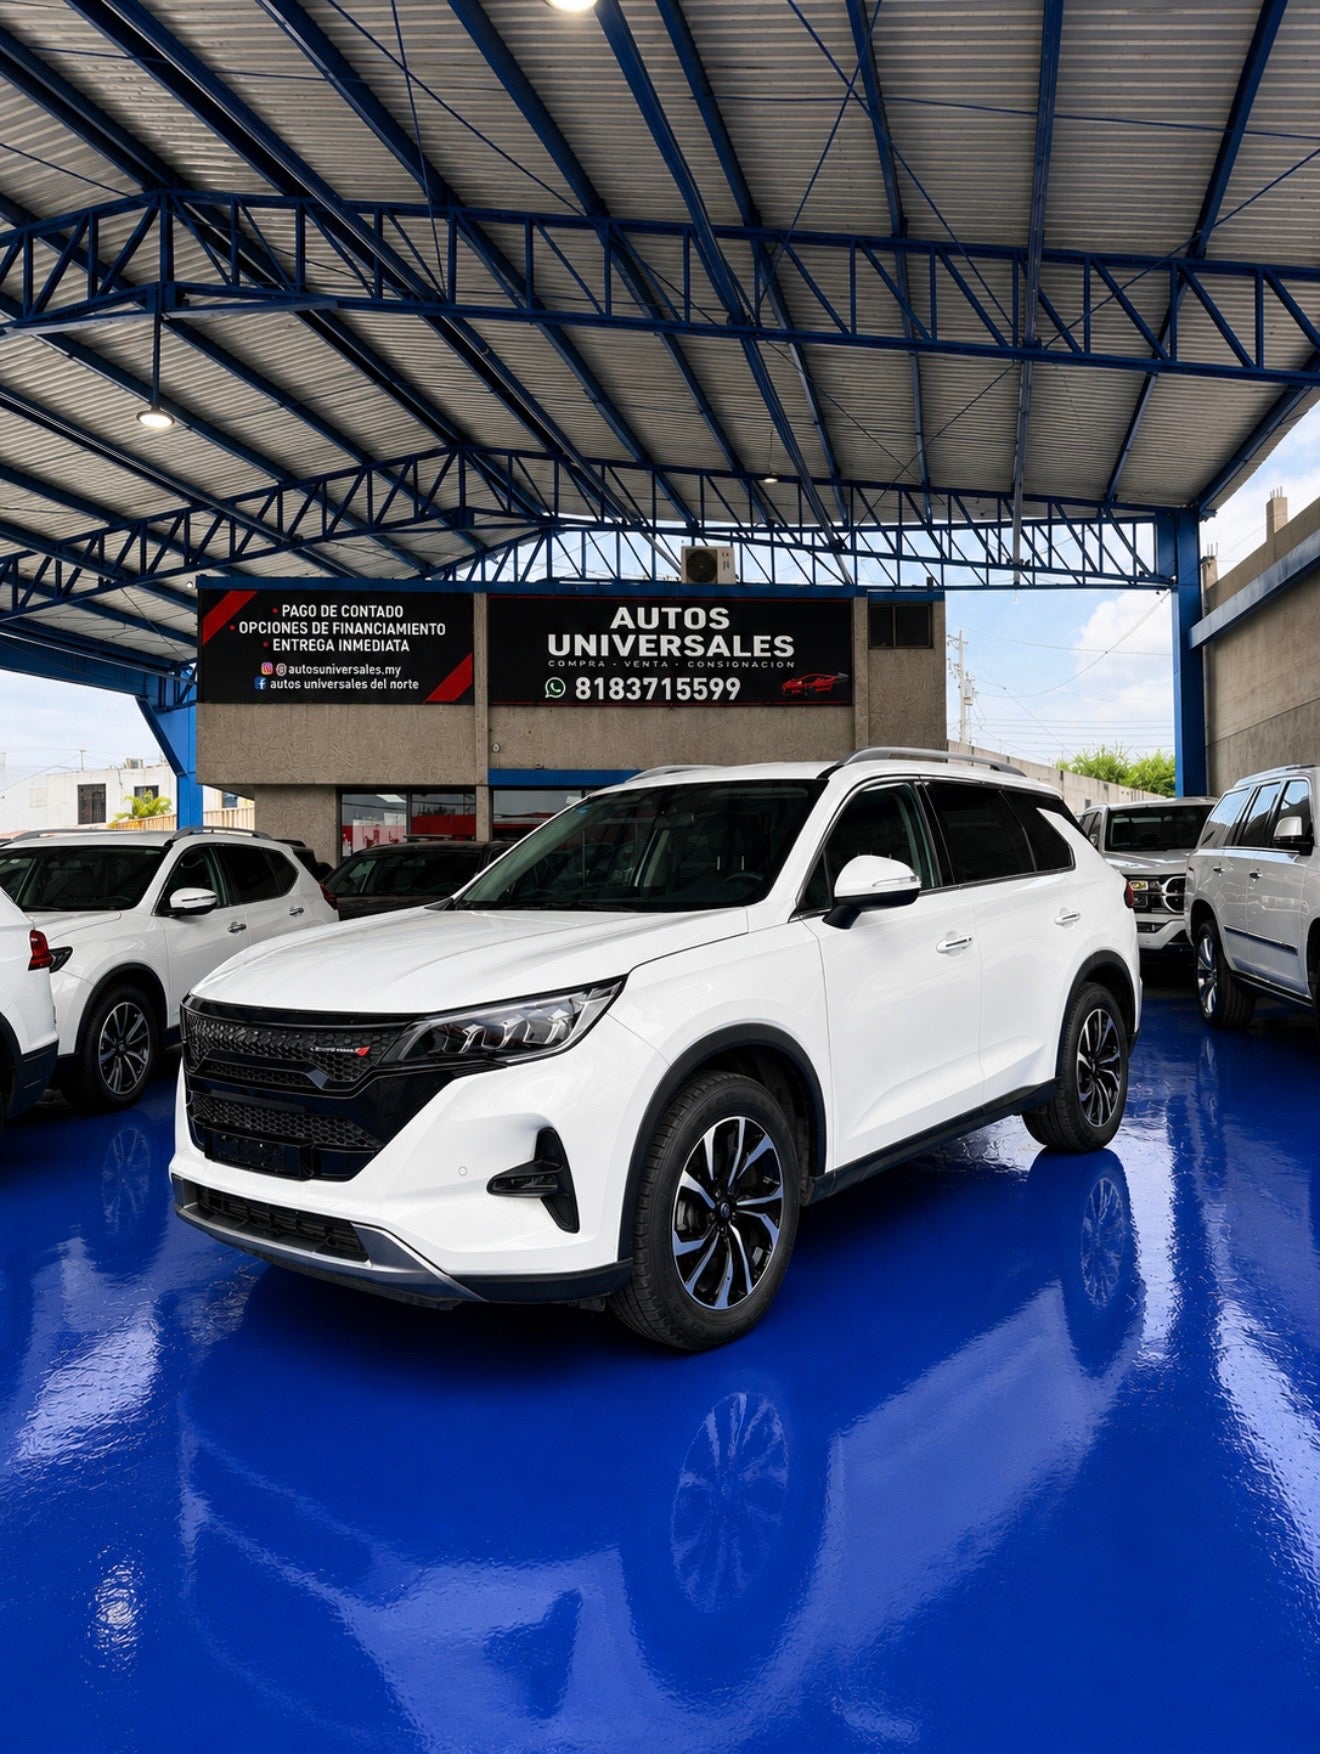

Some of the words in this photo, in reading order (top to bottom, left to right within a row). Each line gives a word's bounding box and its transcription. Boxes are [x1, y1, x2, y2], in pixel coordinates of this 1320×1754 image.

[281, 604, 317, 618] PAGO
[320, 604, 338, 618] DE
[340, 604, 404, 619] CONTADO
[609, 606, 730, 630] AUTOS
[238, 621, 309, 635] OPCIONES
[311, 621, 330, 635] DE
[332, 621, 446, 636] FINANCIAMIENTO
[272, 638, 335, 652] ENTREGA
[338, 638, 411, 652] INMEDIATA
[547, 634, 795, 657] UNIVERSALES
[276, 662, 402, 678] @autosuniversales.my
[547, 660, 606, 668] COMPRA
[624, 660, 668, 668] VENTA
[687, 660, 796, 669] CONSIGNACION
[270, 679, 302, 690] autos
[304, 678, 367, 690] universales
[370, 677, 387, 690] del
[390, 679, 420, 690] norte
[575, 677, 741, 700] 8183715599
